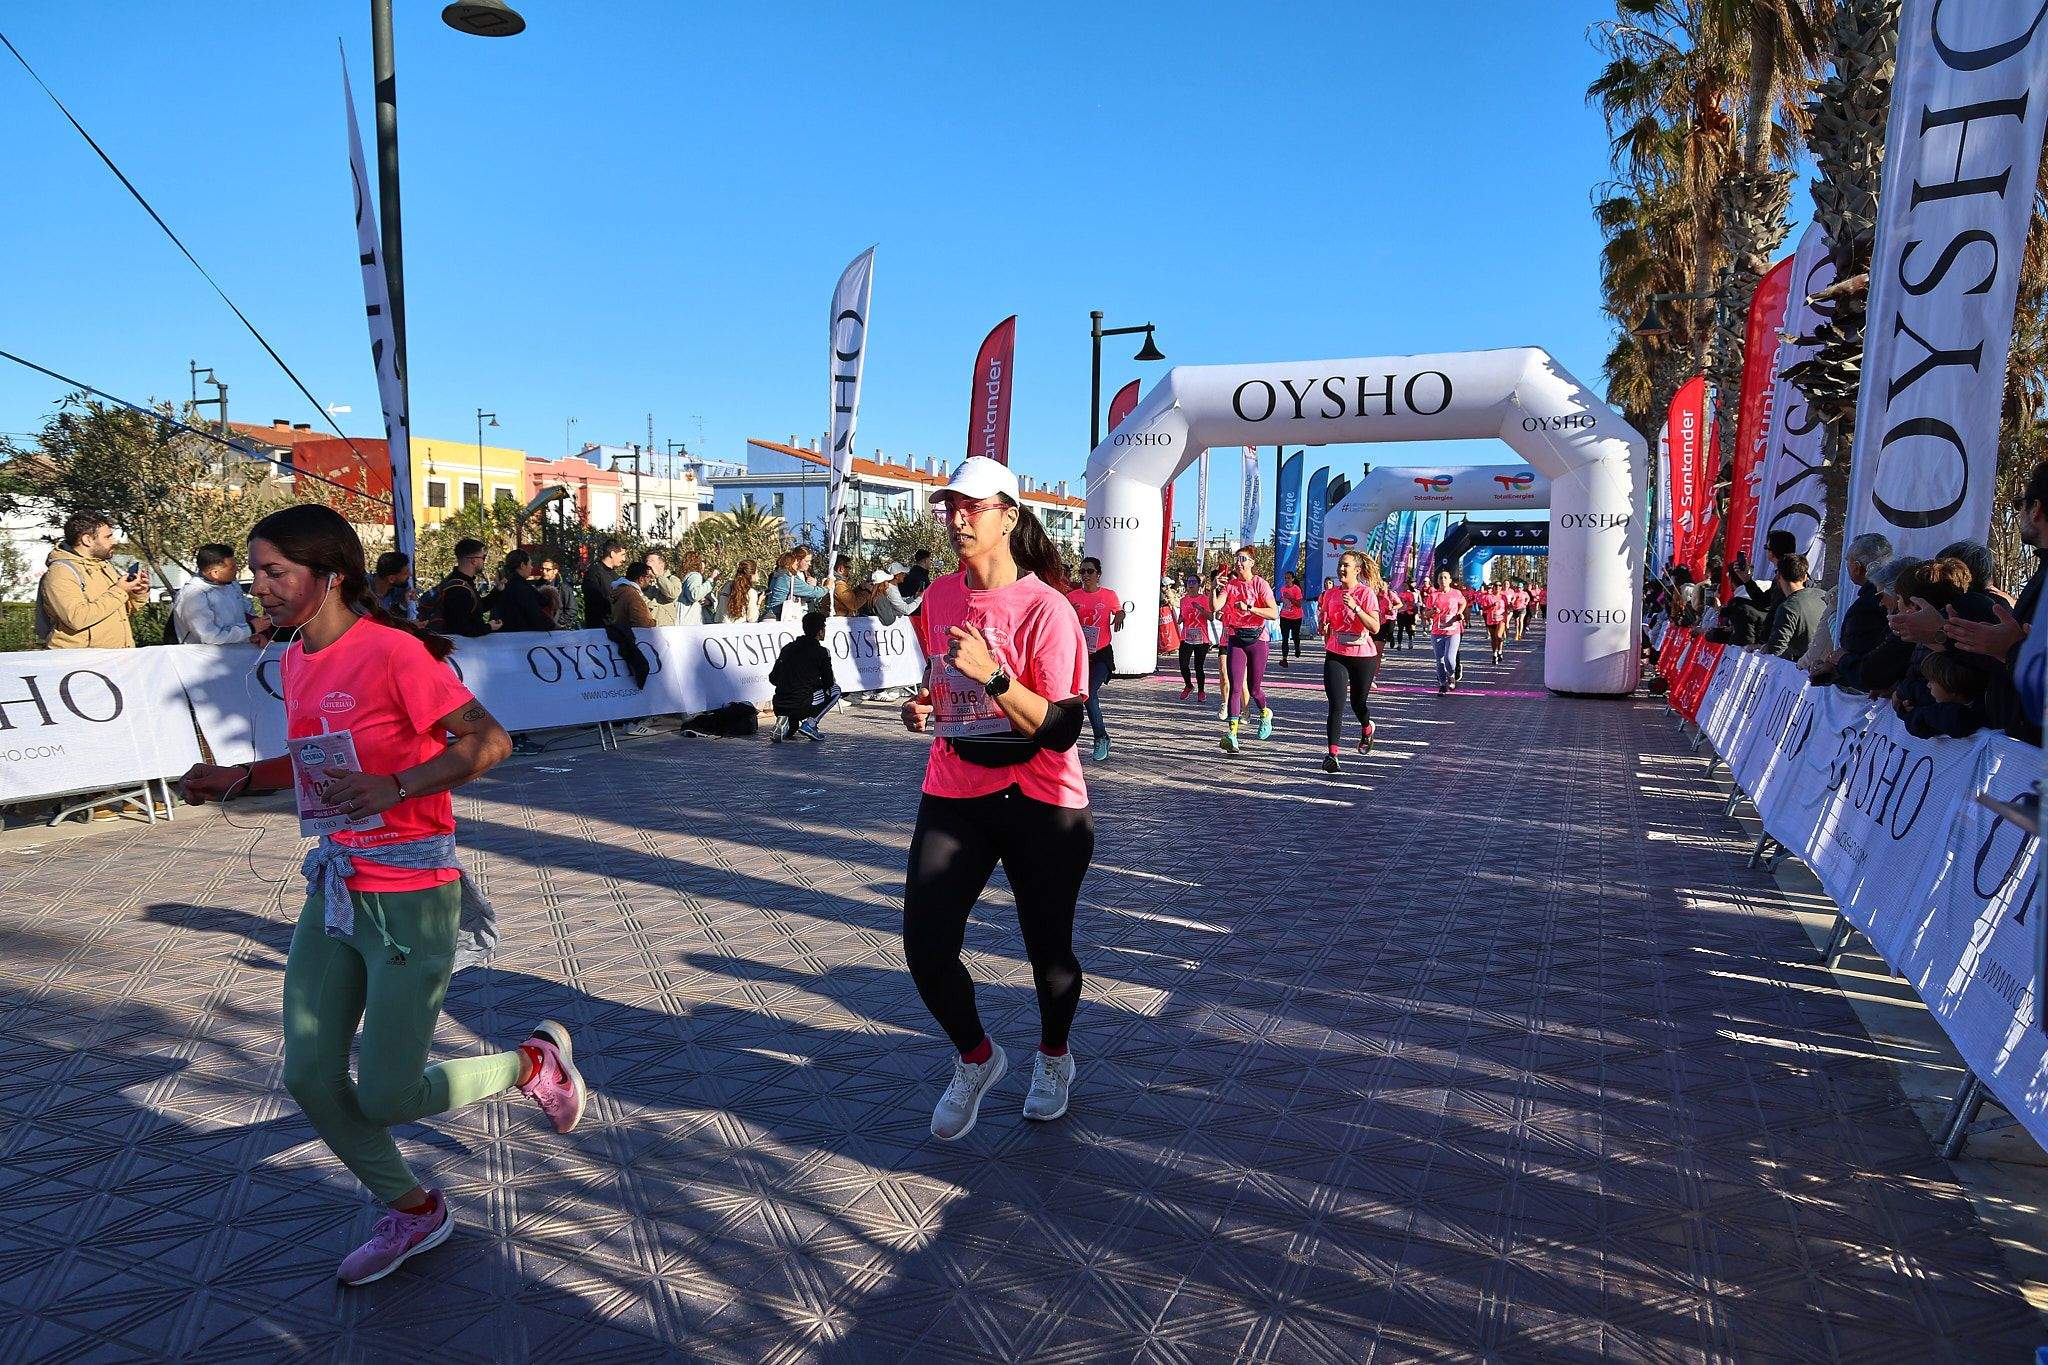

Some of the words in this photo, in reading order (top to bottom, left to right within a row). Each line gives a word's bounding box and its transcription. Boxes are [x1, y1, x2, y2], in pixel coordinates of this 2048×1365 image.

[1872, 0, 2048, 529] OYSHO
[983, 356, 1002, 459] antander
[1233, 371, 1453, 422] OYSHO
[1522, 414, 1597, 432] OYSHO
[1113, 432, 1172, 447] OYSHO
[1681, 409, 1694, 507] Santander
[1087, 516, 1139, 530] OYSHO
[1279, 491, 1298, 546] Marlene
[1308, 499, 1323, 550] Marlene
[1480, 529, 1542, 537] VOLV
[1561, 513, 1630, 529] OYSHO
[1557, 608, 1626, 624] OYSHO
[833, 628, 905, 660] OYSHO
